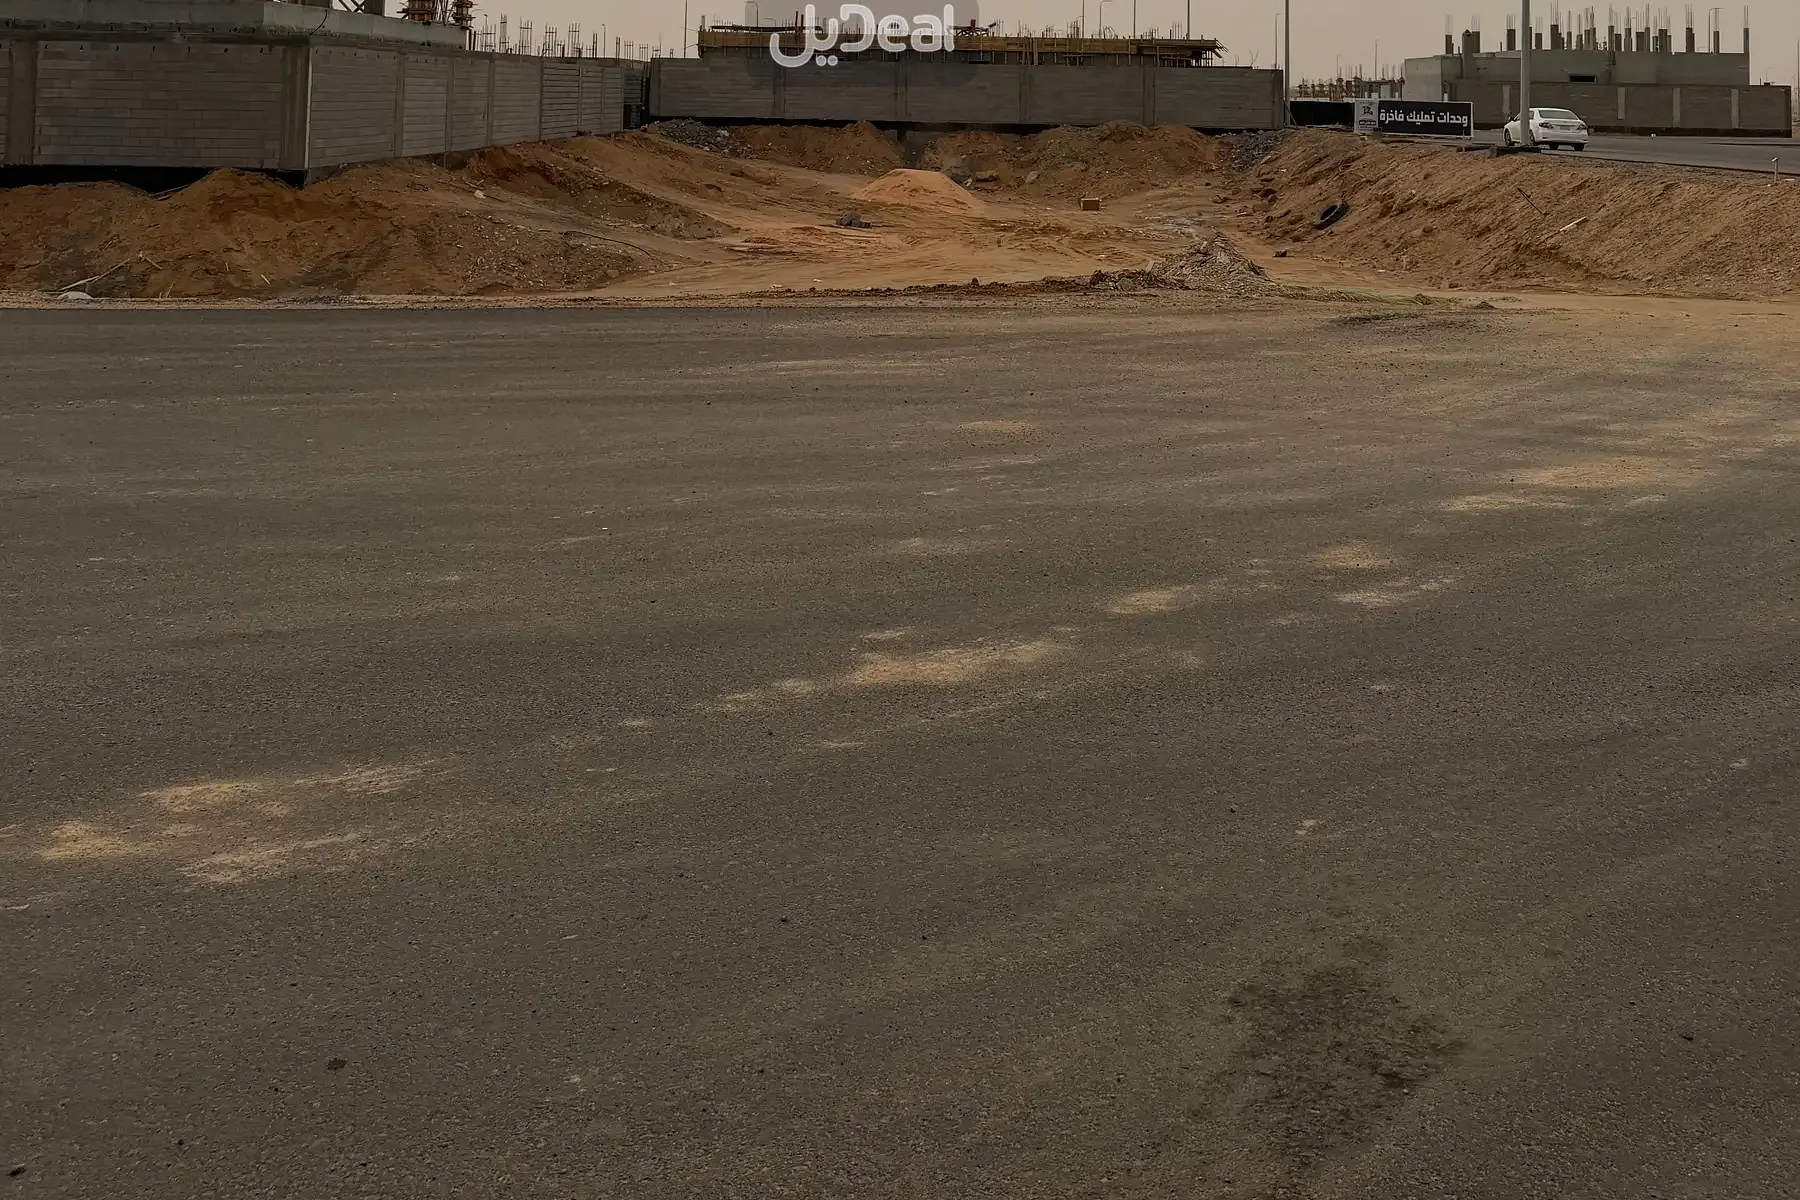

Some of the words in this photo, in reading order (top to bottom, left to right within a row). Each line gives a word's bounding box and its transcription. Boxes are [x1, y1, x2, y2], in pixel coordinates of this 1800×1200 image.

[1379, 109, 1405, 124] فاخرة
[1406, 110, 1436, 125] تمليك
[1437, 111, 1468, 127] وحدات
